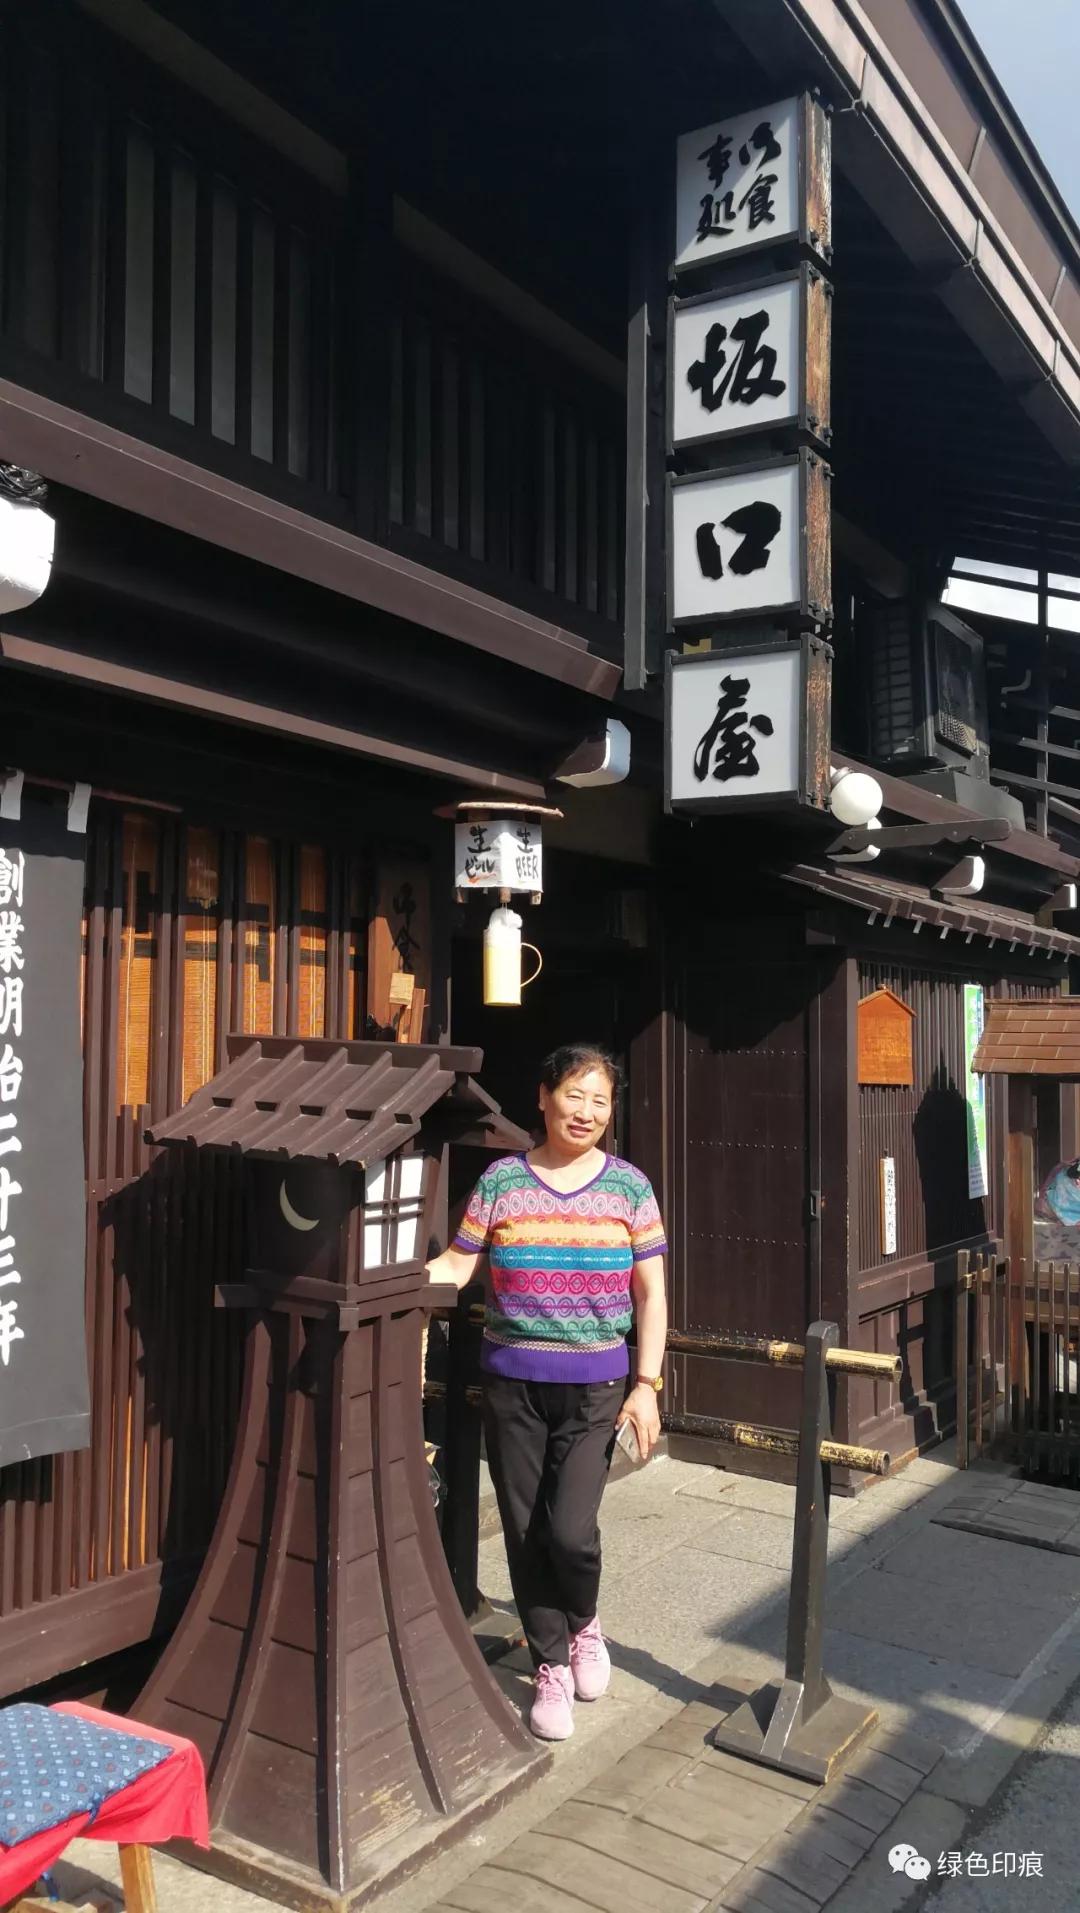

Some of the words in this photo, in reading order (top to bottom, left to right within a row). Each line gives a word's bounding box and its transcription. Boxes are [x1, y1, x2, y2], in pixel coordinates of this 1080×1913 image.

[687, 309, 786, 782] 坂口屋
[467, 824, 492, 854] 生
[516, 826, 534, 854] 生
[515, 854, 539, 880] BEER
